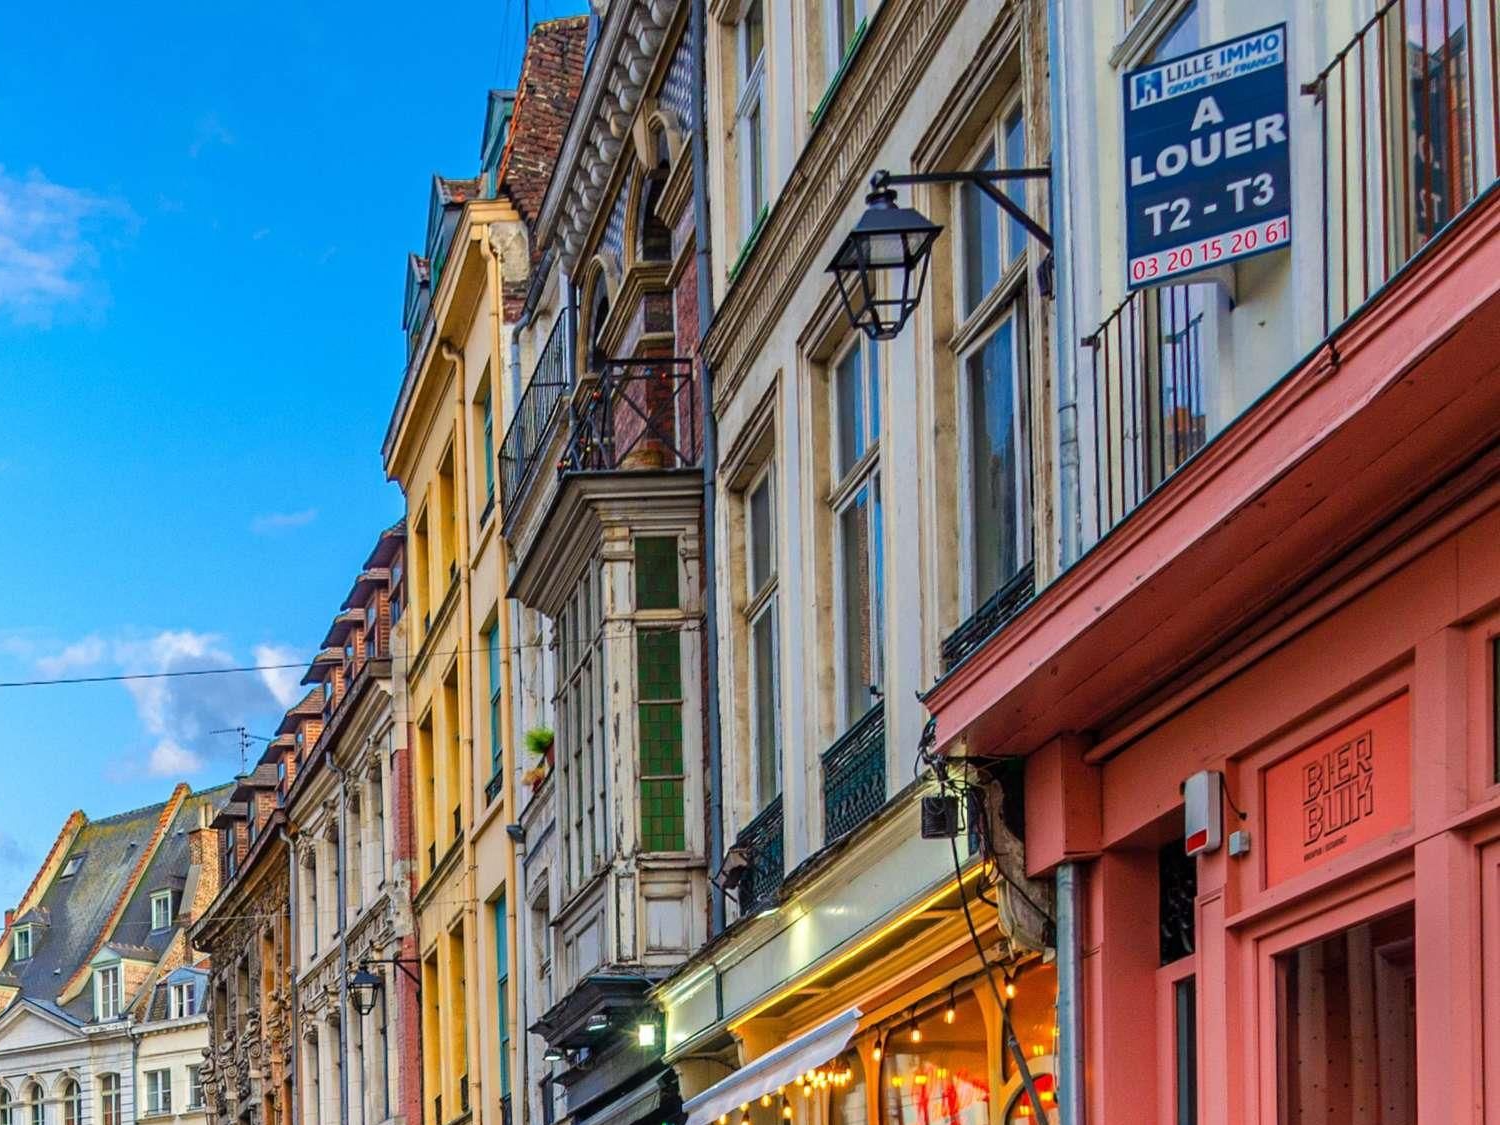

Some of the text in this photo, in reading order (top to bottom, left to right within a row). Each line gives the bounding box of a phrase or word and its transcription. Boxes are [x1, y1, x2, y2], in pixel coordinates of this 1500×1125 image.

[1166, 33, 1279, 83] LILLE IMMO
[1167, 52, 1279, 96] GROUPE TMC FINANCE
[1190, 96, 1224, 132] A
[1130, 113, 1287, 187] LOUER
[1144, 198, 1191, 236] T2
[1226, 172, 1274, 213] T3
[1133, 219, 1287, 281] 03 20 15 20 61
